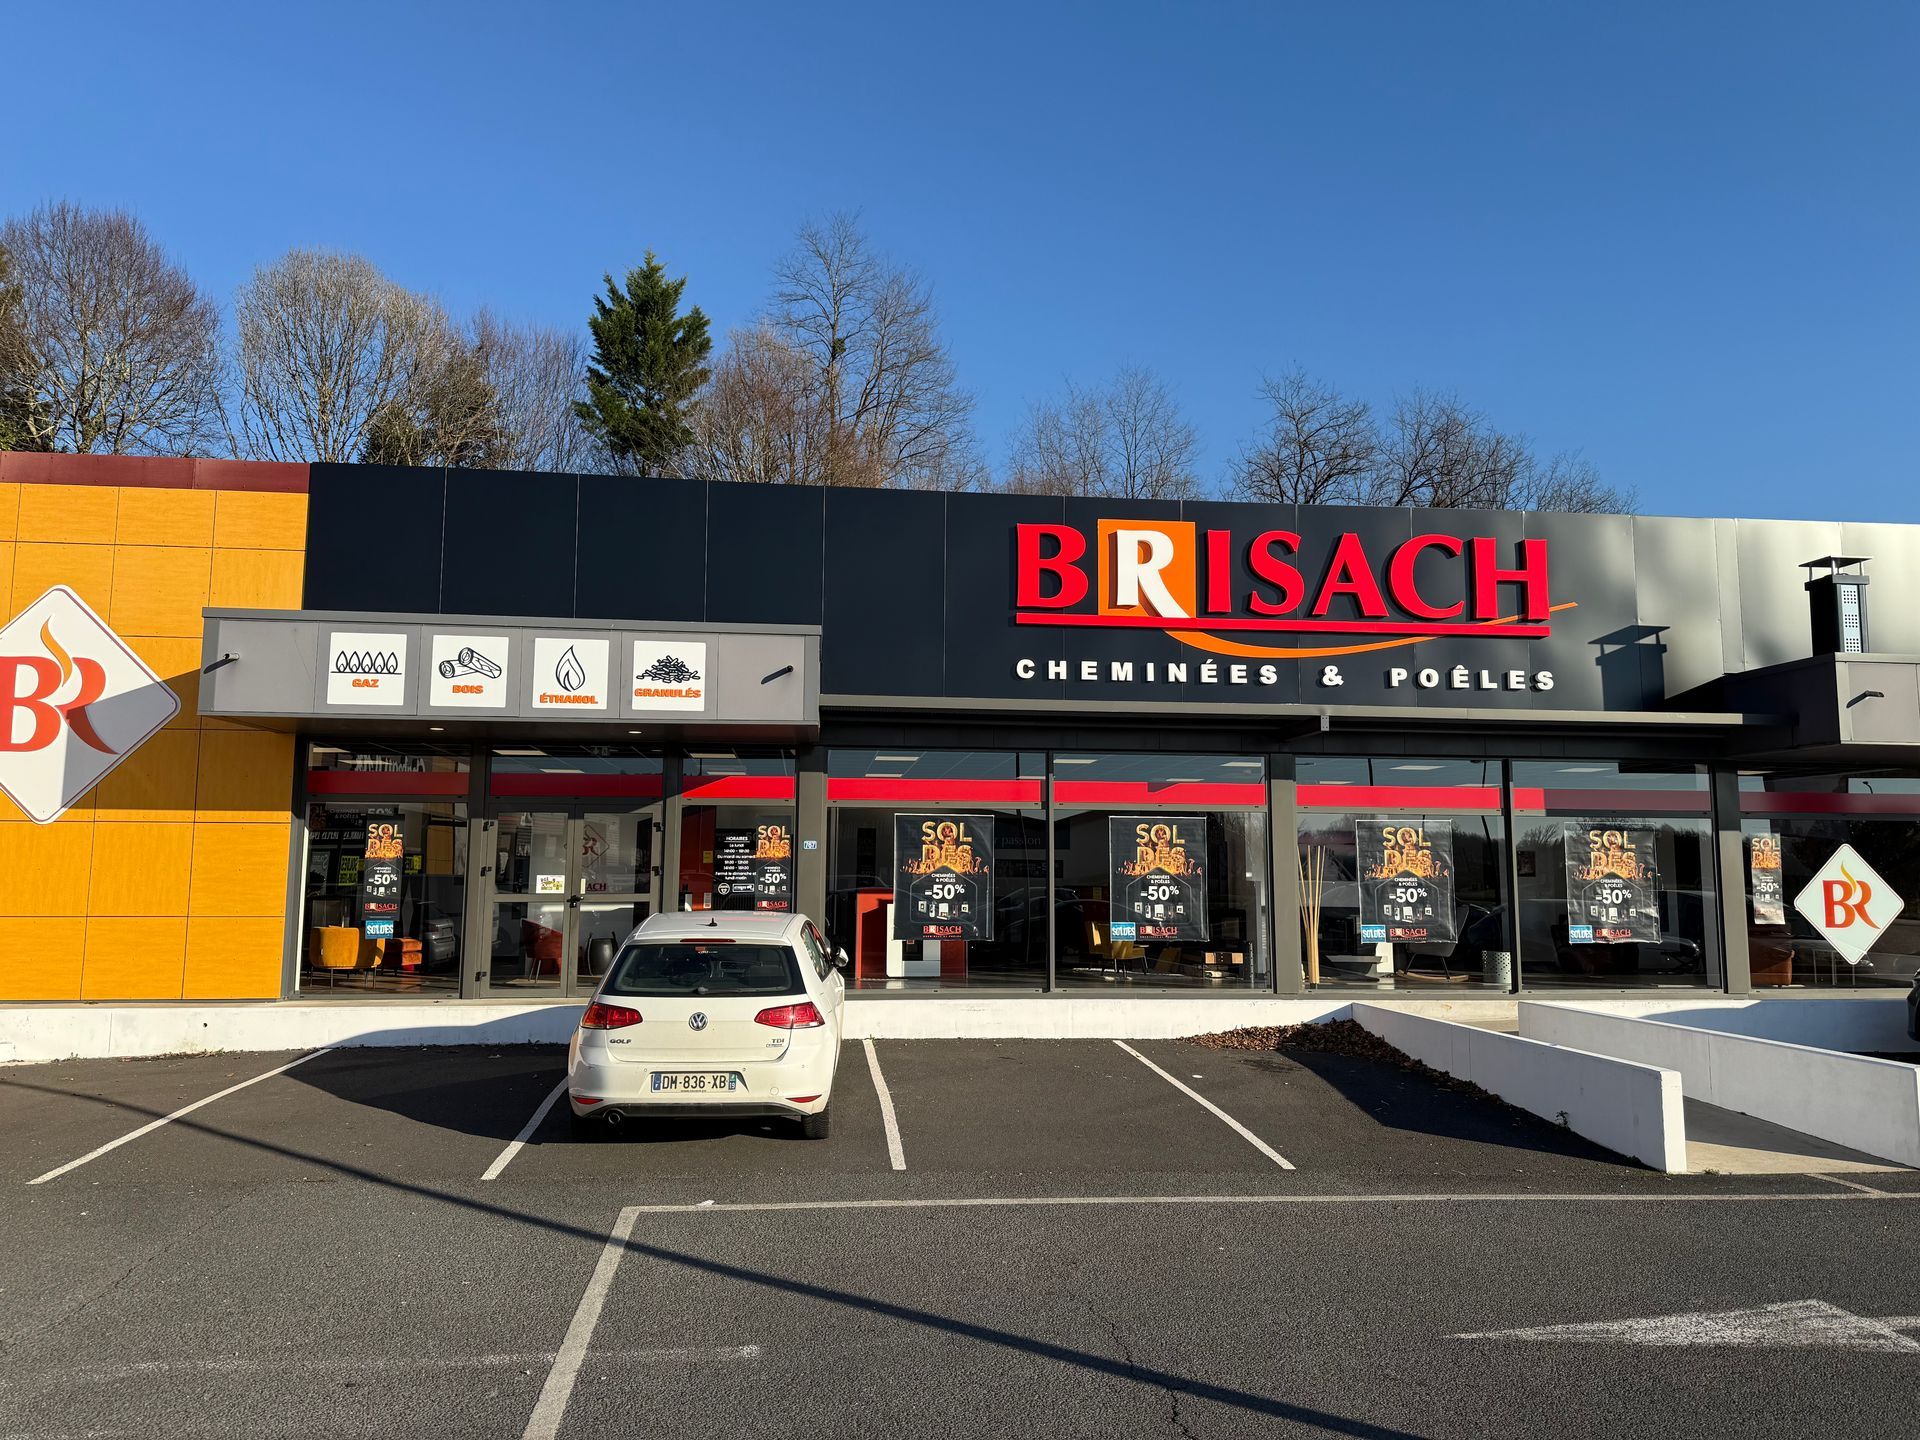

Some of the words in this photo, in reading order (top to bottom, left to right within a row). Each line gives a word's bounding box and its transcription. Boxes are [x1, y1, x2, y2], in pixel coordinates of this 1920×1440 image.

[1015, 521, 1550, 622] BRISACH
[1015, 657, 1278, 686] CHEMINÉES
[1322, 665, 1345, 687] &
[1389, 664, 1555, 691] POÊLES
[351, 678, 379, 688] GAZ
[452, 684, 484, 695] BOIS
[634, 685, 701, 698] GRANULÉS
[539, 692, 599, 705] ÉTHANOL
[368, 823, 403, 837] SOL
[758, 825, 790, 838] SOL
[921, 821, 972, 842] SOL
[1136, 823, 1185, 844] SOL
[1382, 827, 1431, 847] SOL
[1589, 830, 1636, 849] SOL
[1752, 837, 1780, 850] SOL
[1822, 879, 1881, 930] BR
[366, 924, 393, 934] SOLDES
[923, 925, 962, 934] BRISACH
[1112, 926, 1135, 936] SOLDES
[1362, 929, 1386, 938] SOLDES
[1570, 929, 1592, 938] SOLDES
[662, 1075, 727, 1090] DM-836-XB
